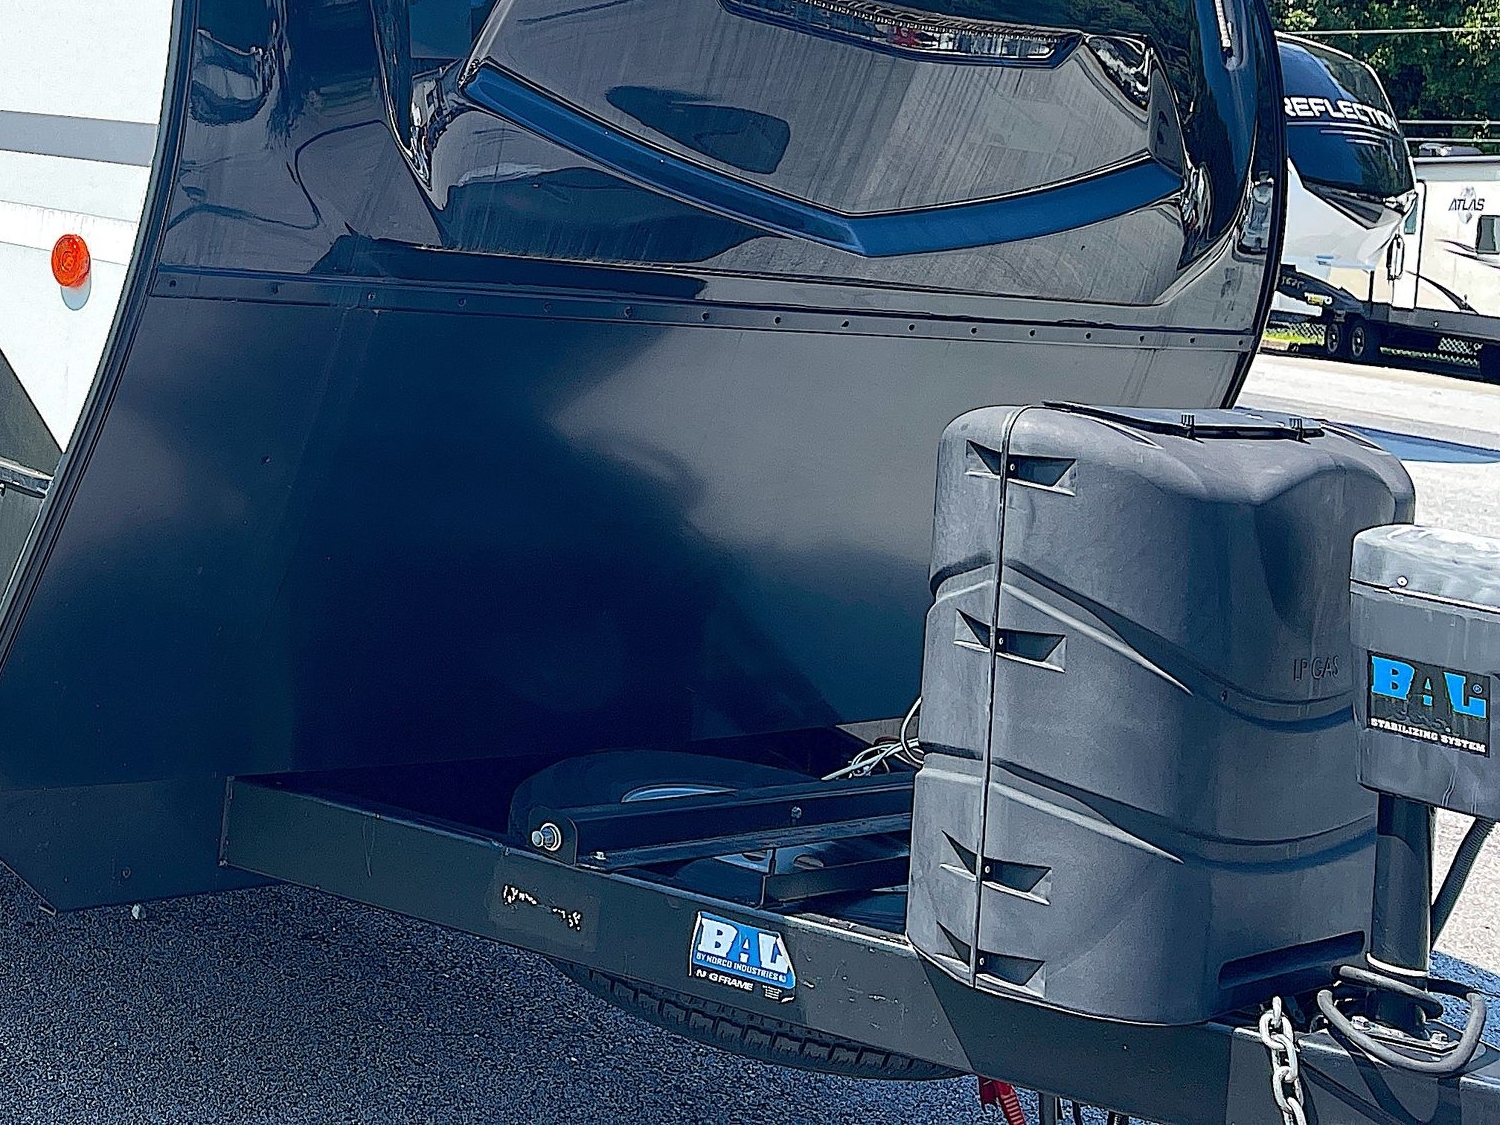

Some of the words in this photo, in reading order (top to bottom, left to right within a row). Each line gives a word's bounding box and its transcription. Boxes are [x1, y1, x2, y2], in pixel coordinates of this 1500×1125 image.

[1448, 197, 1486, 212] ATLAS
[1311, 654, 1340, 680] GAS
[1371, 655, 1487, 719] BAL
[1370, 717, 1439, 742] STABILIZING
[1440, 734, 1487, 753] SYSTEM
[697, 917, 789, 974] BAL
[695, 952, 706, 961] BY
[706, 954, 733, 969] NORCO
[733, 961, 778, 981] INDUSTRIES
